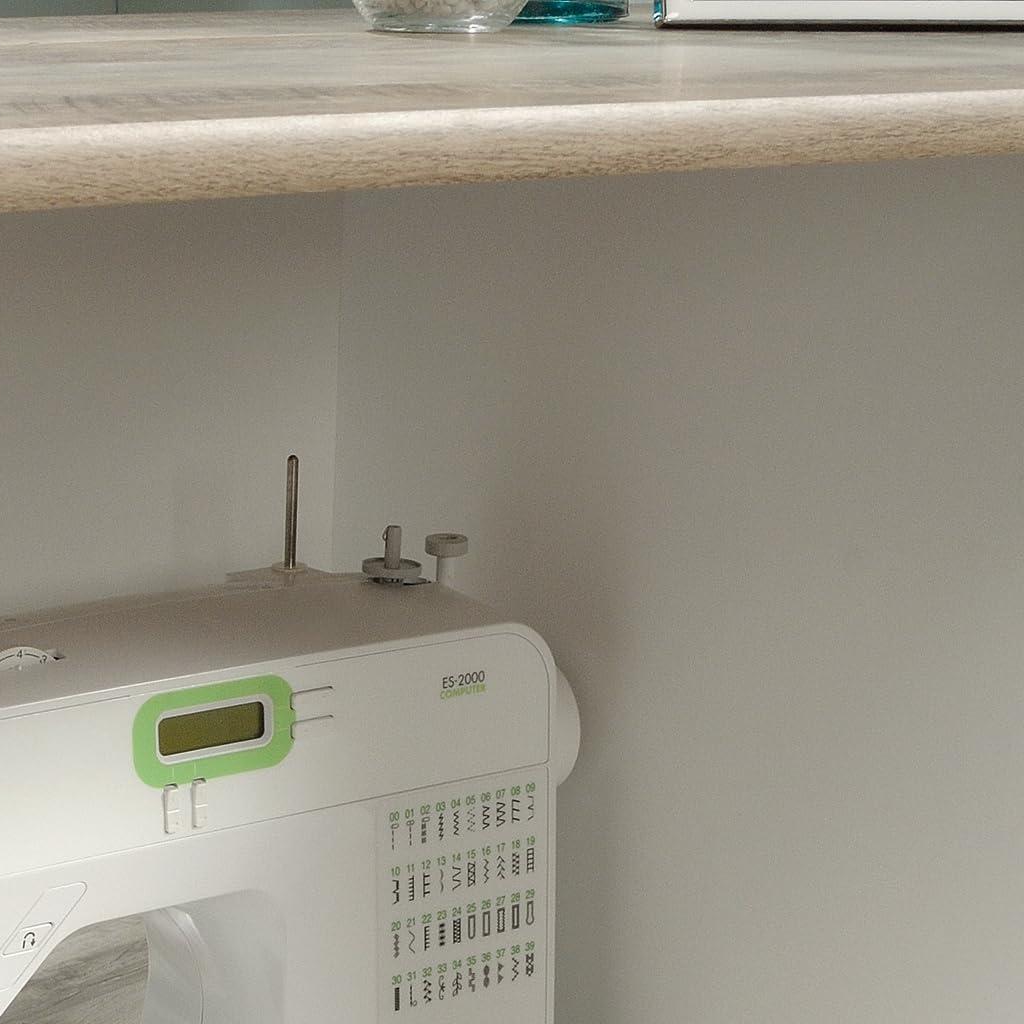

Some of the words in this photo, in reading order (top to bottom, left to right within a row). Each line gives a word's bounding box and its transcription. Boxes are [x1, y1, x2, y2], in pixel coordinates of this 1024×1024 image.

[16, 650, 23, 659] 4
[440, 683, 486, 700] COMPUTER
[442, 670, 486, 689] ES-2000
[389, 811, 400, 822] 00
[405, 809, 414, 819] 01
[420, 804, 430, 815] 02
[435, 802, 446, 812] 03
[450, 799, 461, 809] 04
[466, 796, 476, 805] 05
[481, 792, 491, 802] 06
[496, 789, 506, 799] 07
[511, 786, 520, 796] 08
[526, 783, 535, 793] 09
[391, 866, 400, 877] 10
[407, 863, 415, 873] 11
[422, 860, 431, 870] 12
[437, 856, 446, 866] 13
[452, 853, 461, 862] 14
[467, 850, 476, 859] 15
[482, 846, 491, 856] 16
[497, 843, 506, 852] 17
[511, 839, 520, 849] 18
[526, 836, 535, 846] 19
[391, 921, 401, 931] 20
[407, 918, 415, 928] 21
[422, 914, 432, 923] 22
[437, 910, 447, 920] 23
[452, 907, 462, 917] 24
[467, 903, 477, 913] 25
[481, 899, 491, 910] 26
[496, 896, 506, 906] 27
[511, 892, 520, 902] 28
[525, 889, 535, 899] 29
[391, 975, 402, 985] 30
[407, 972, 416, 981] 31
[422, 967, 432, 978] 32
[437, 963, 447, 973] 33
[452, 960, 462, 970] 34
[467, 956, 476, 966] 35
[481, 952, 491, 962] 36
[496, 949, 505, 958] 37
[510, 945, 520, 955] 38
[525, 941, 535, 951] 39
